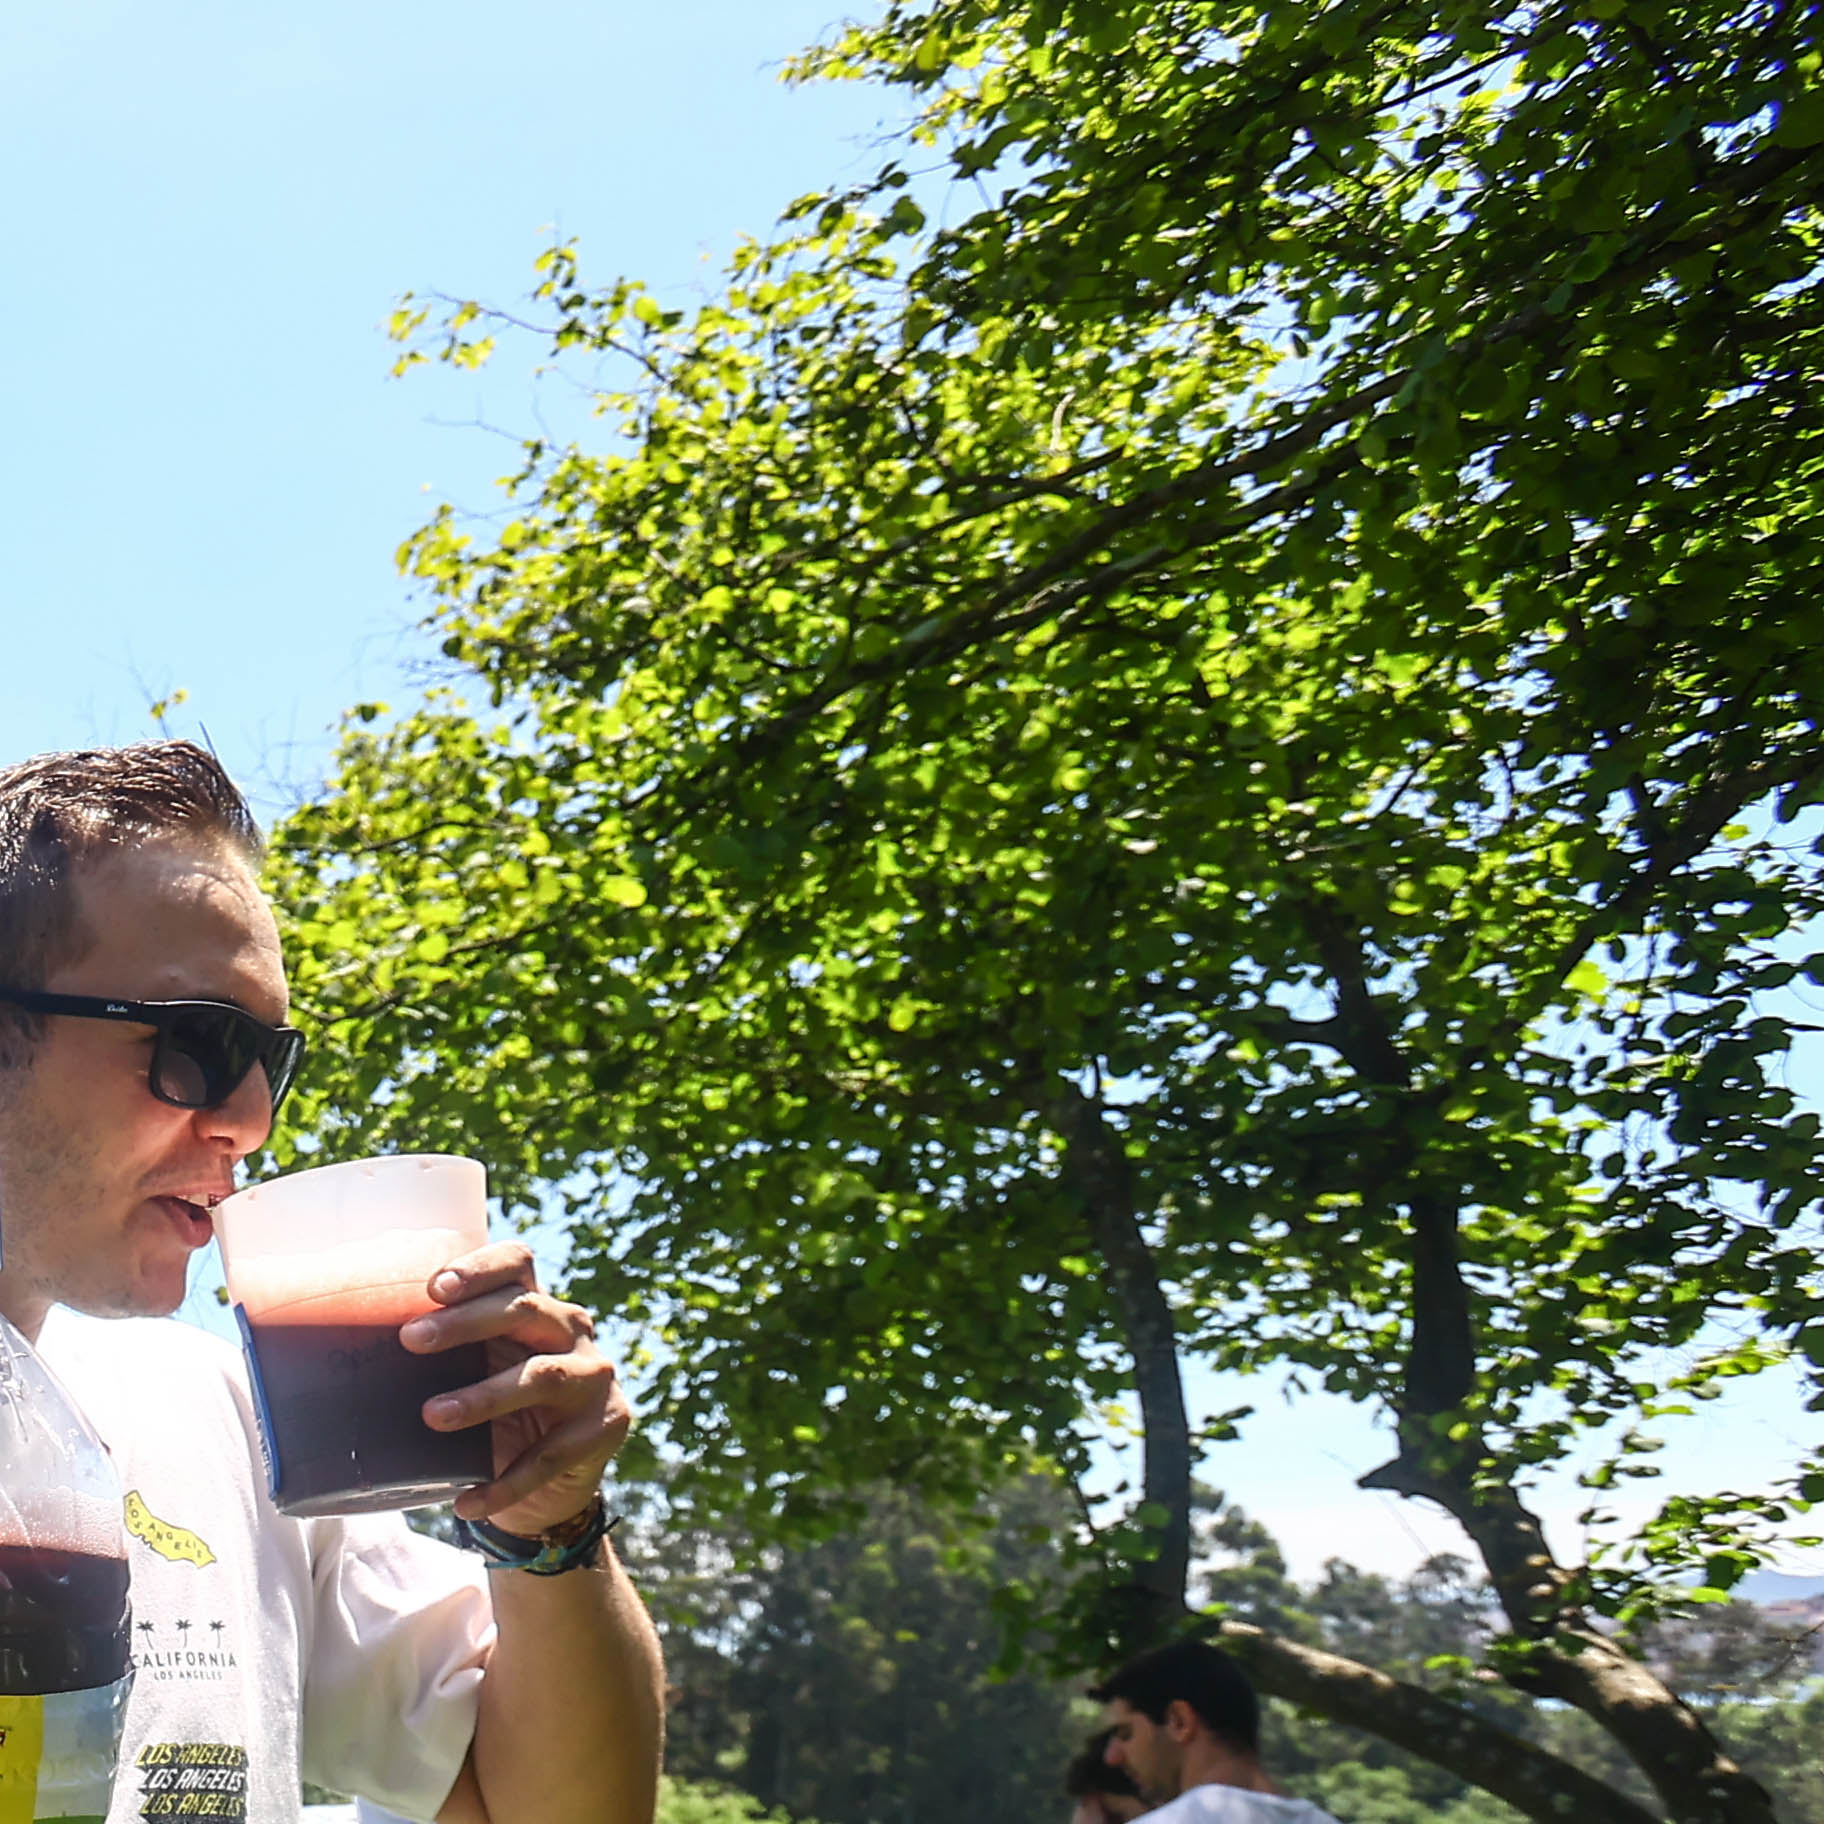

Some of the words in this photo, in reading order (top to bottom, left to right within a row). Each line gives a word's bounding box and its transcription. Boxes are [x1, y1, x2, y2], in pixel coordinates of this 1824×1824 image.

[132, 1652, 238, 1669] CALIFORNIA
[154, 1671, 174, 1681] LOS
[179, 1671, 223, 1681] ANGELES
[135, 1743, 177, 1766] LOS
[175, 1743, 245, 1766] ANGELES
[140, 1768, 178, 1790] LOS
[174, 1768, 246, 1792] ANGELES
[138, 1792, 178, 1815] LOS
[175, 1792, 245, 1817] ANGELES
